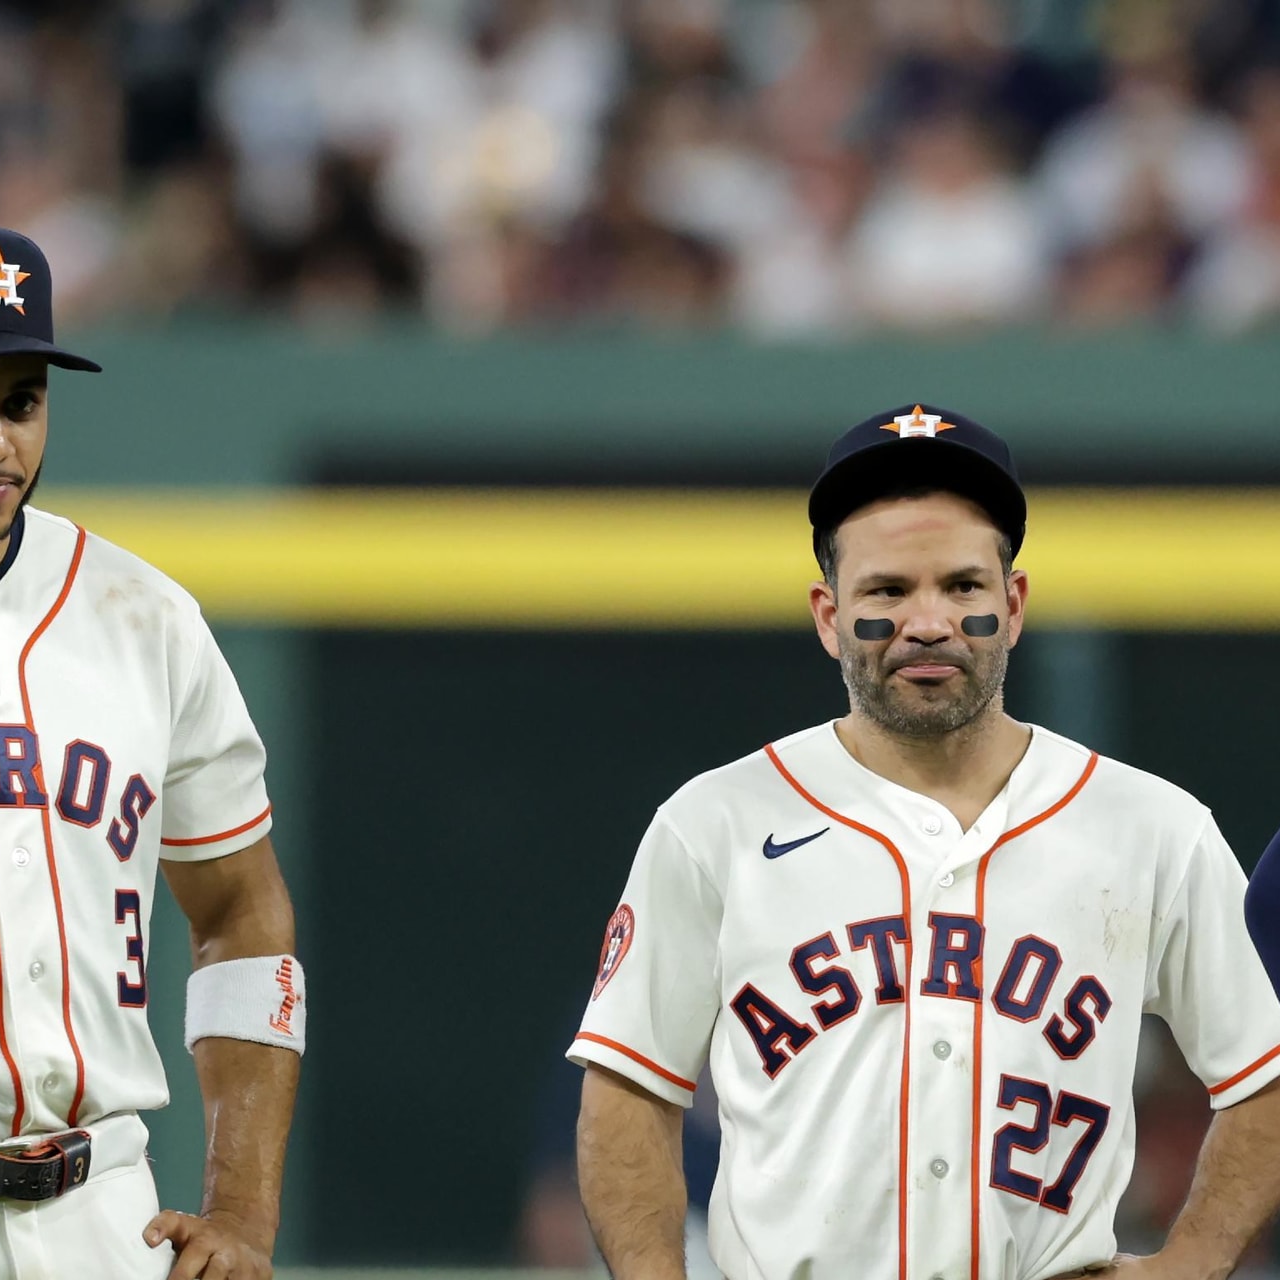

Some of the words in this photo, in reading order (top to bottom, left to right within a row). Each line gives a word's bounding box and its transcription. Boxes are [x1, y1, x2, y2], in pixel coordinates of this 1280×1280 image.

[115, 889, 148, 1009] 3
[730, 911, 1113, 1080] ASTROS
[73, 1157, 84, 1183] 3
[990, 1073, 1111, 1215] 27
